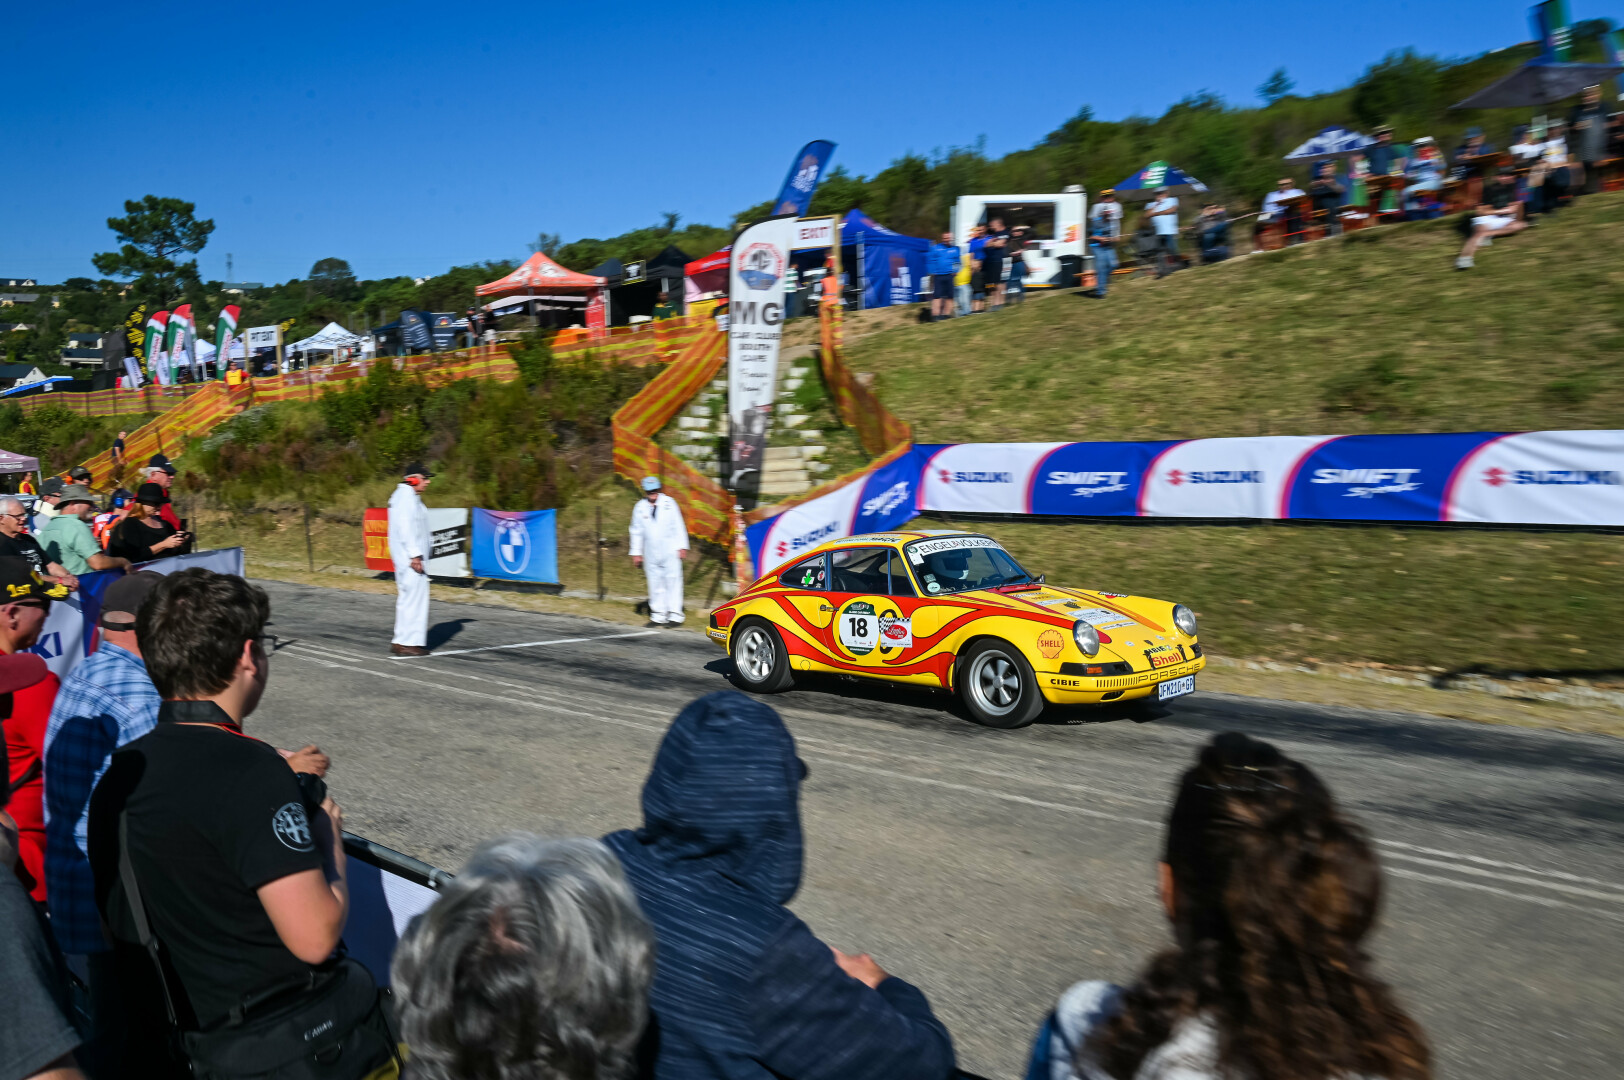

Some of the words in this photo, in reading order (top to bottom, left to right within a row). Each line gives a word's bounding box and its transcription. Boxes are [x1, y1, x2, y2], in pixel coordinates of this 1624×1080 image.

[800, 226, 831, 241] EXIT
[730, 301, 784, 325] MG
[954, 472, 1013, 483] SUZUKI
[1046, 472, 1128, 485] SWIFT
[1188, 471, 1264, 483] SUZUKI
[1311, 469, 1421, 484] SWIFT
[1512, 470, 1622, 485] SUZUKI
[790, 521, 840, 550] SUZUKI
[849, 617, 868, 638] 18
[1040, 640, 1061, 648] SHELL
[1152, 652, 1182, 667] Shell
[1138, 662, 1200, 684] PORSCHE
[1050, 678, 1080, 687] CIBIE
